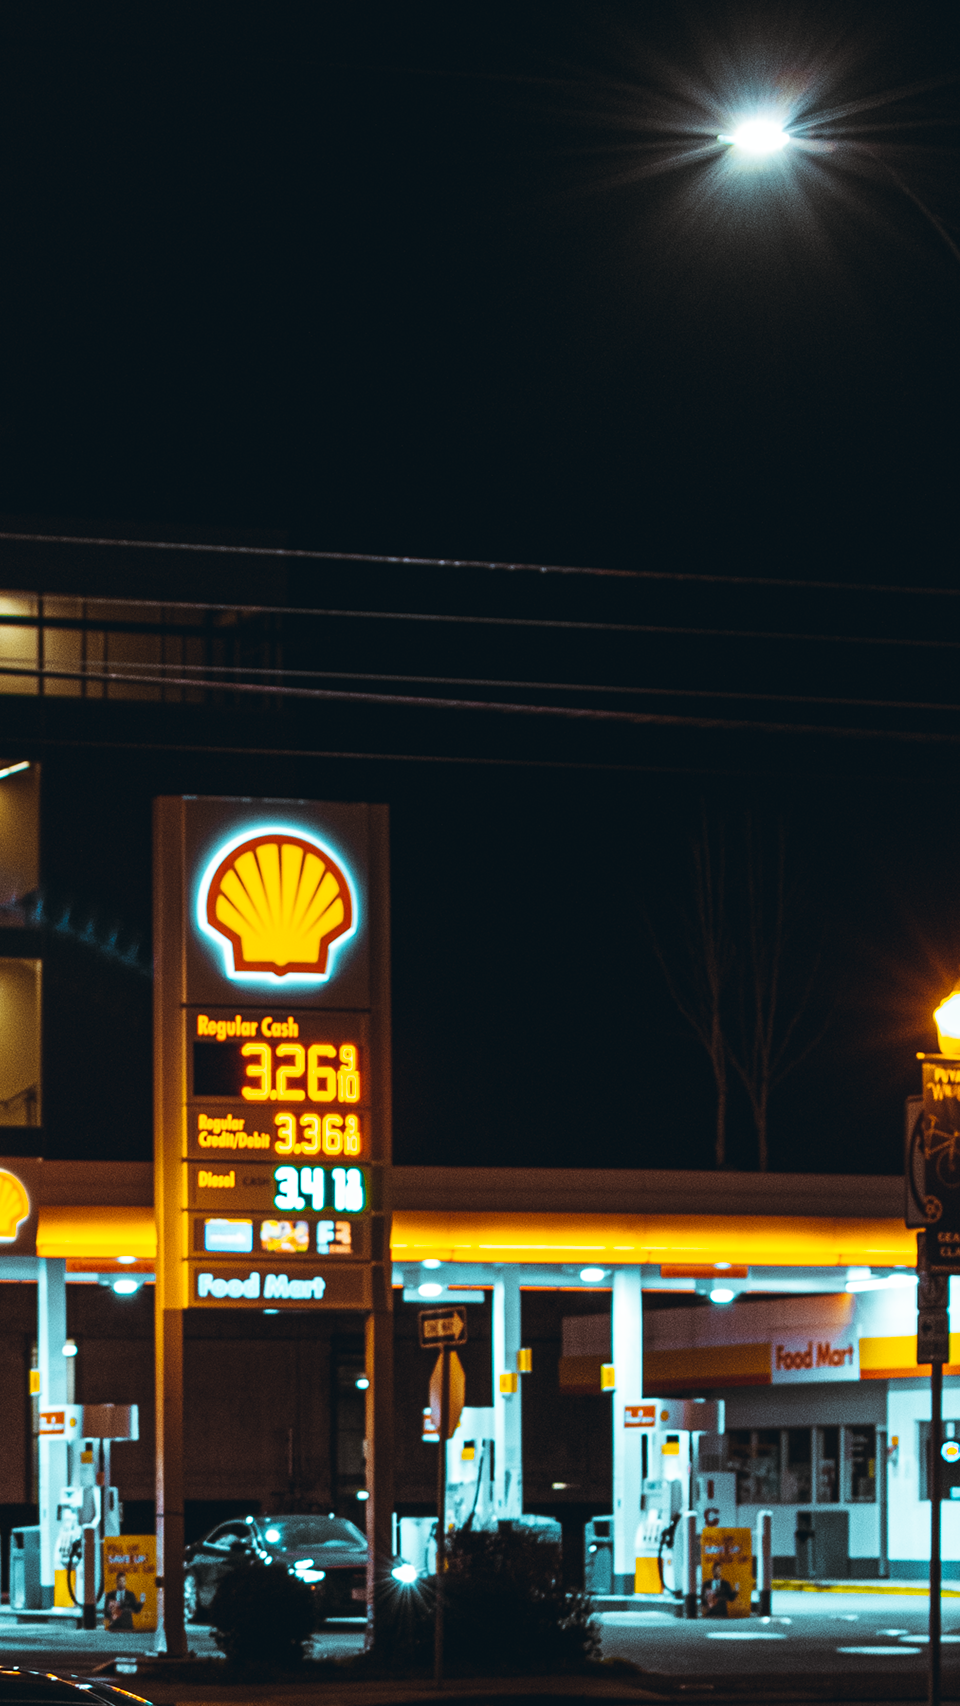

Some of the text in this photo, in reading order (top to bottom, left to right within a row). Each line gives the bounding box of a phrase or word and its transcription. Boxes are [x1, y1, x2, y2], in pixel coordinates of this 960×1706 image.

[197, 1014, 300, 1042] Regular Cash
[198, 1113, 245, 1134] Regular
[198, 1130, 271, 1149] Credit/Debit
[197, 1170, 236, 1188] Diesel
[197, 1271, 326, 1299] Food Mart
[776, 1341, 854, 1370] Food Mart
